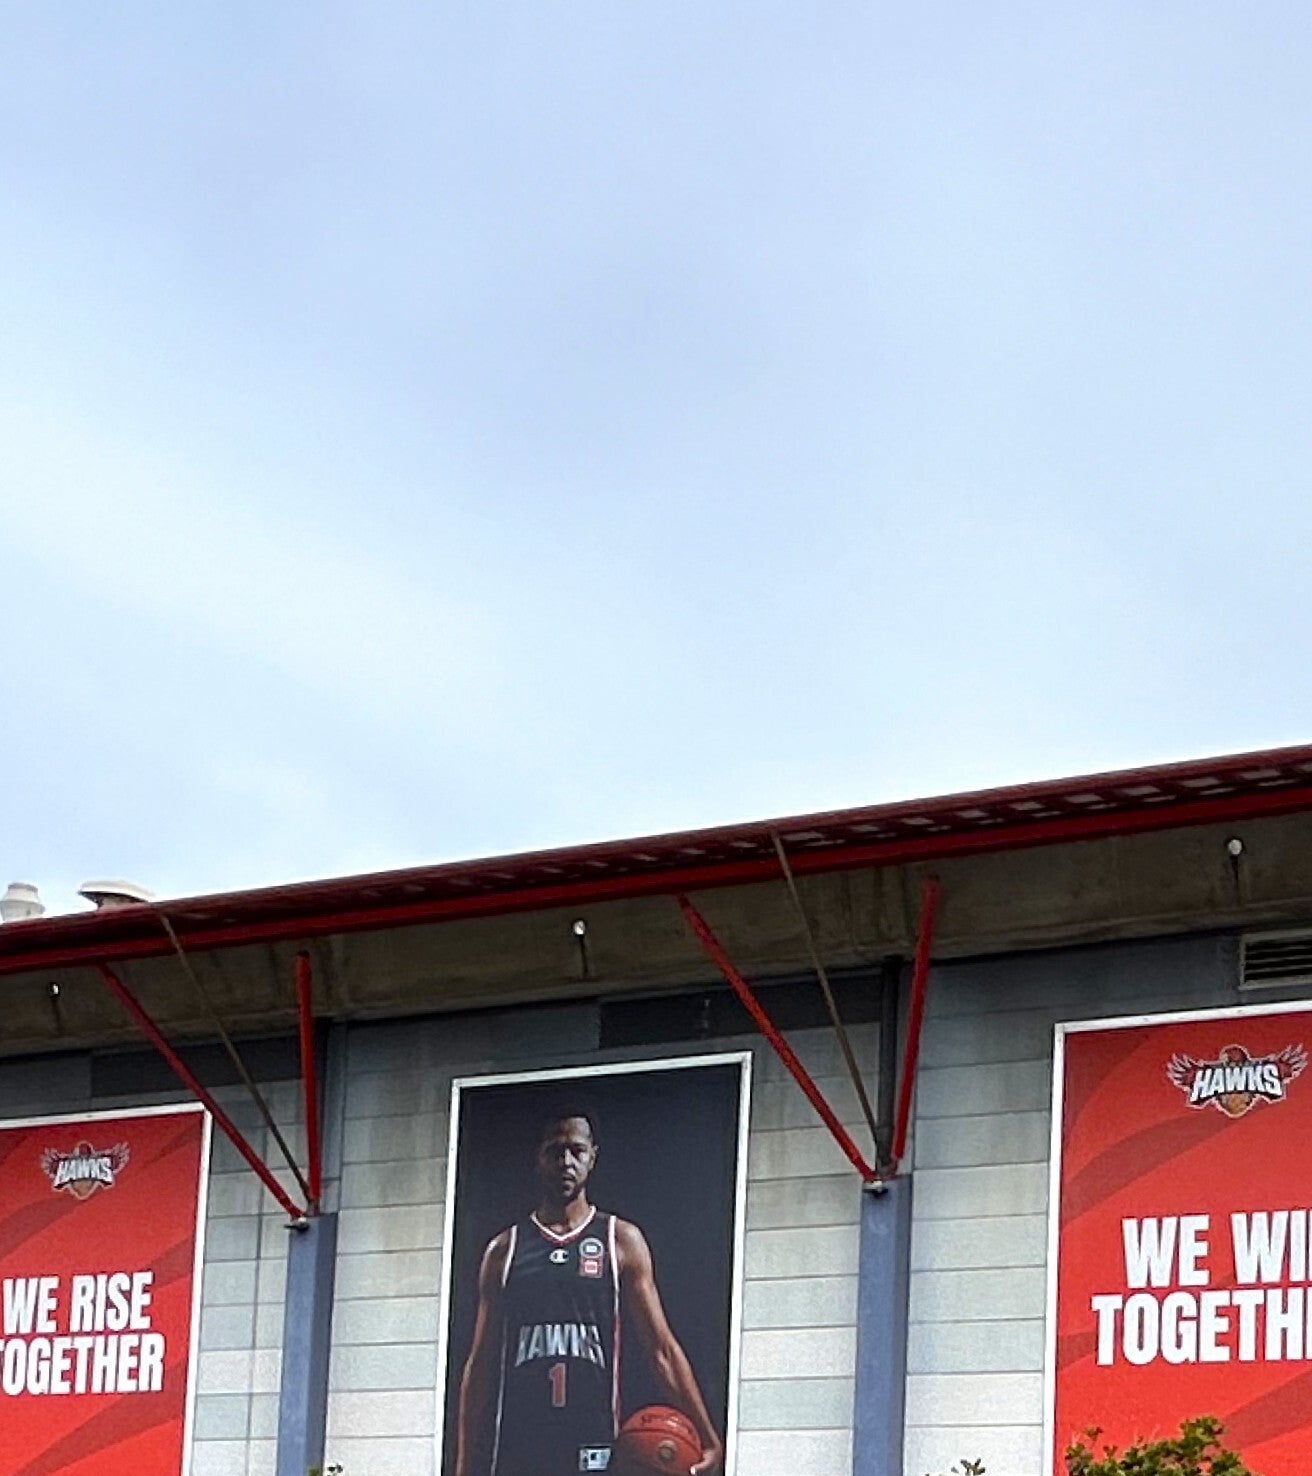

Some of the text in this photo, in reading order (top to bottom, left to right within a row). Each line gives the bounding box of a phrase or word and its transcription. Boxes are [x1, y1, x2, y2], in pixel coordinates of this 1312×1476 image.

[1190, 1063, 1282, 1102] HAWKS
[54, 1157, 113, 1187] HAWKS
[1122, 1214, 1210, 1288] WE
[2, 1271, 155, 1334] WE RISE
[549, 1362, 566, 1407] 1
